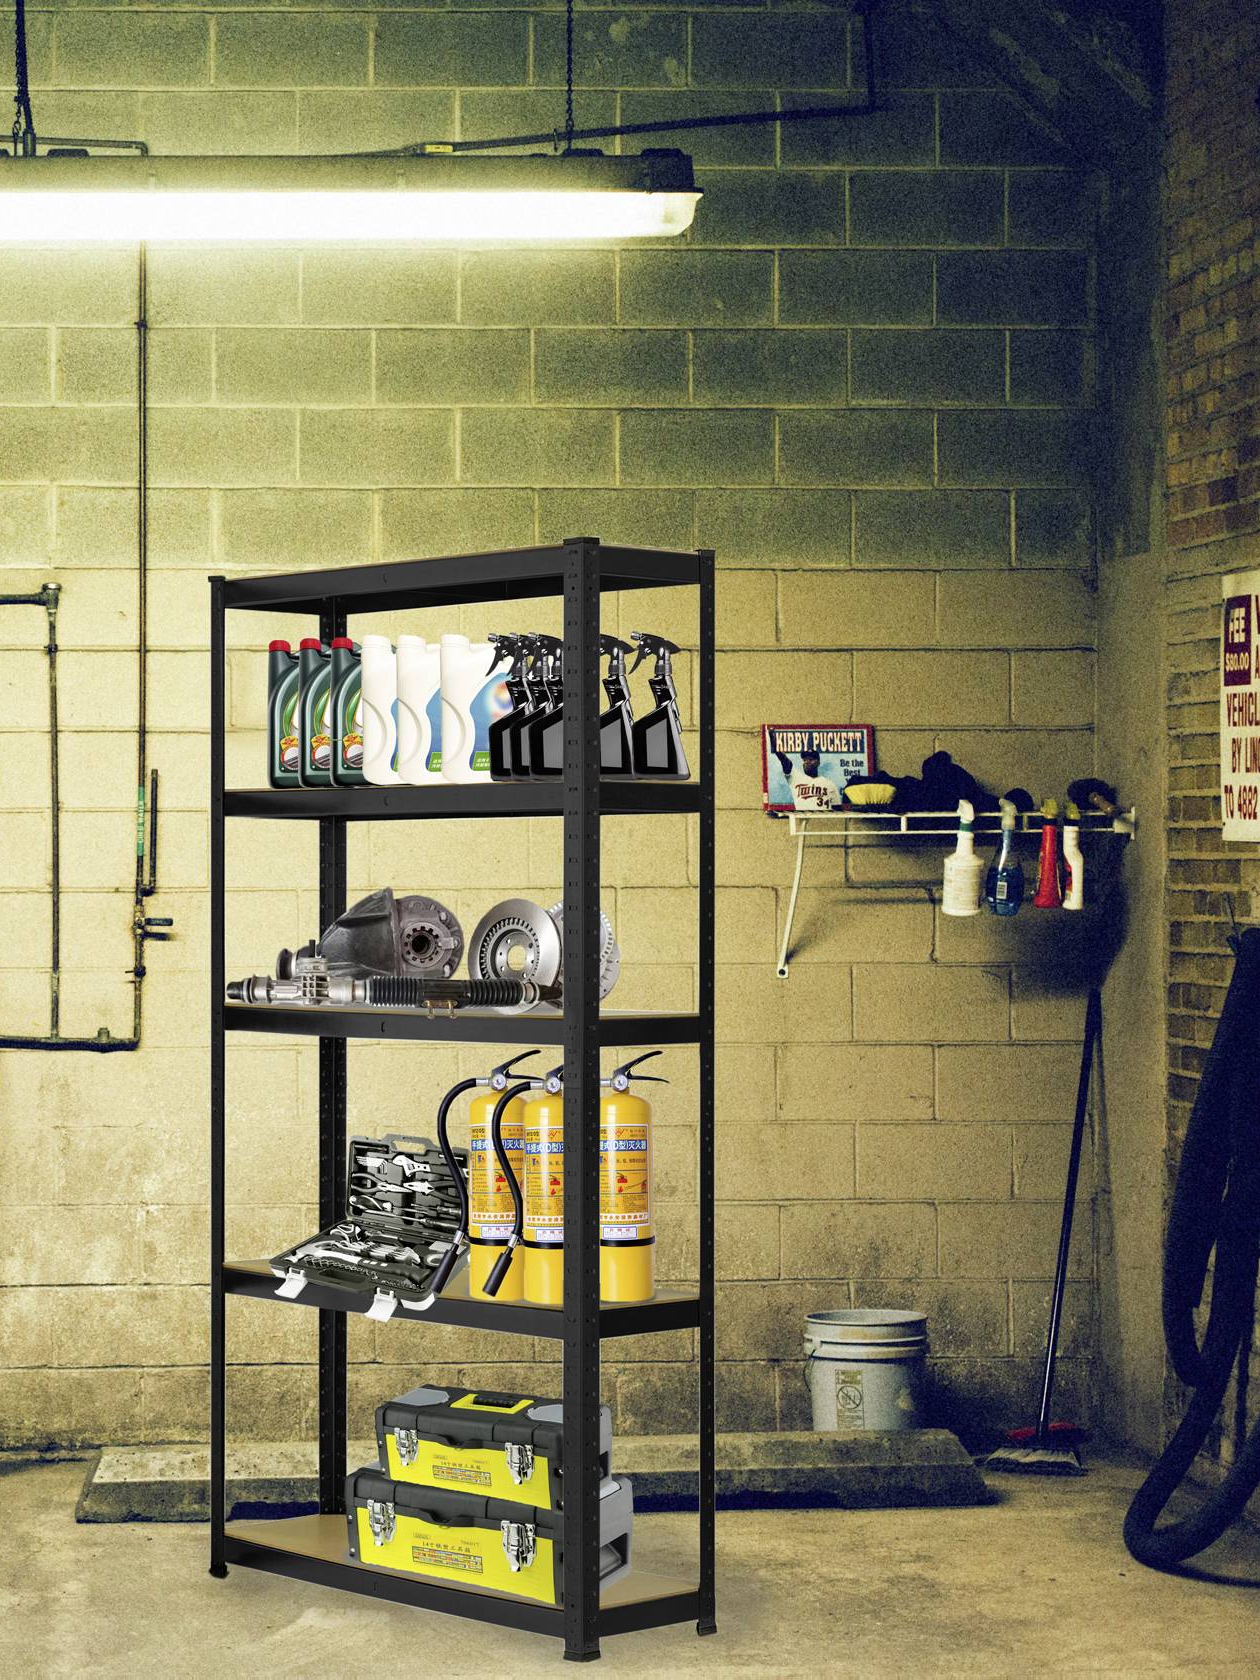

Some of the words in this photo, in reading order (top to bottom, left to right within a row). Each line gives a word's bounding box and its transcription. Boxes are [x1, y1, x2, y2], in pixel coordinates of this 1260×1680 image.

[1228, 607, 1246, 643] FEE
[775, 732, 809, 752] KIRBY
[812, 732, 862, 752] PUCKETT
[840, 759, 850, 768] Be
[851, 759, 864, 768] the
[1232, 737, 1242, 773] BY
[795, 784, 827, 799] Twins
[817, 797, 830, 809] 34
[1224, 785, 1234, 819] TO
[1238, 785, 1258, 820] 4882
